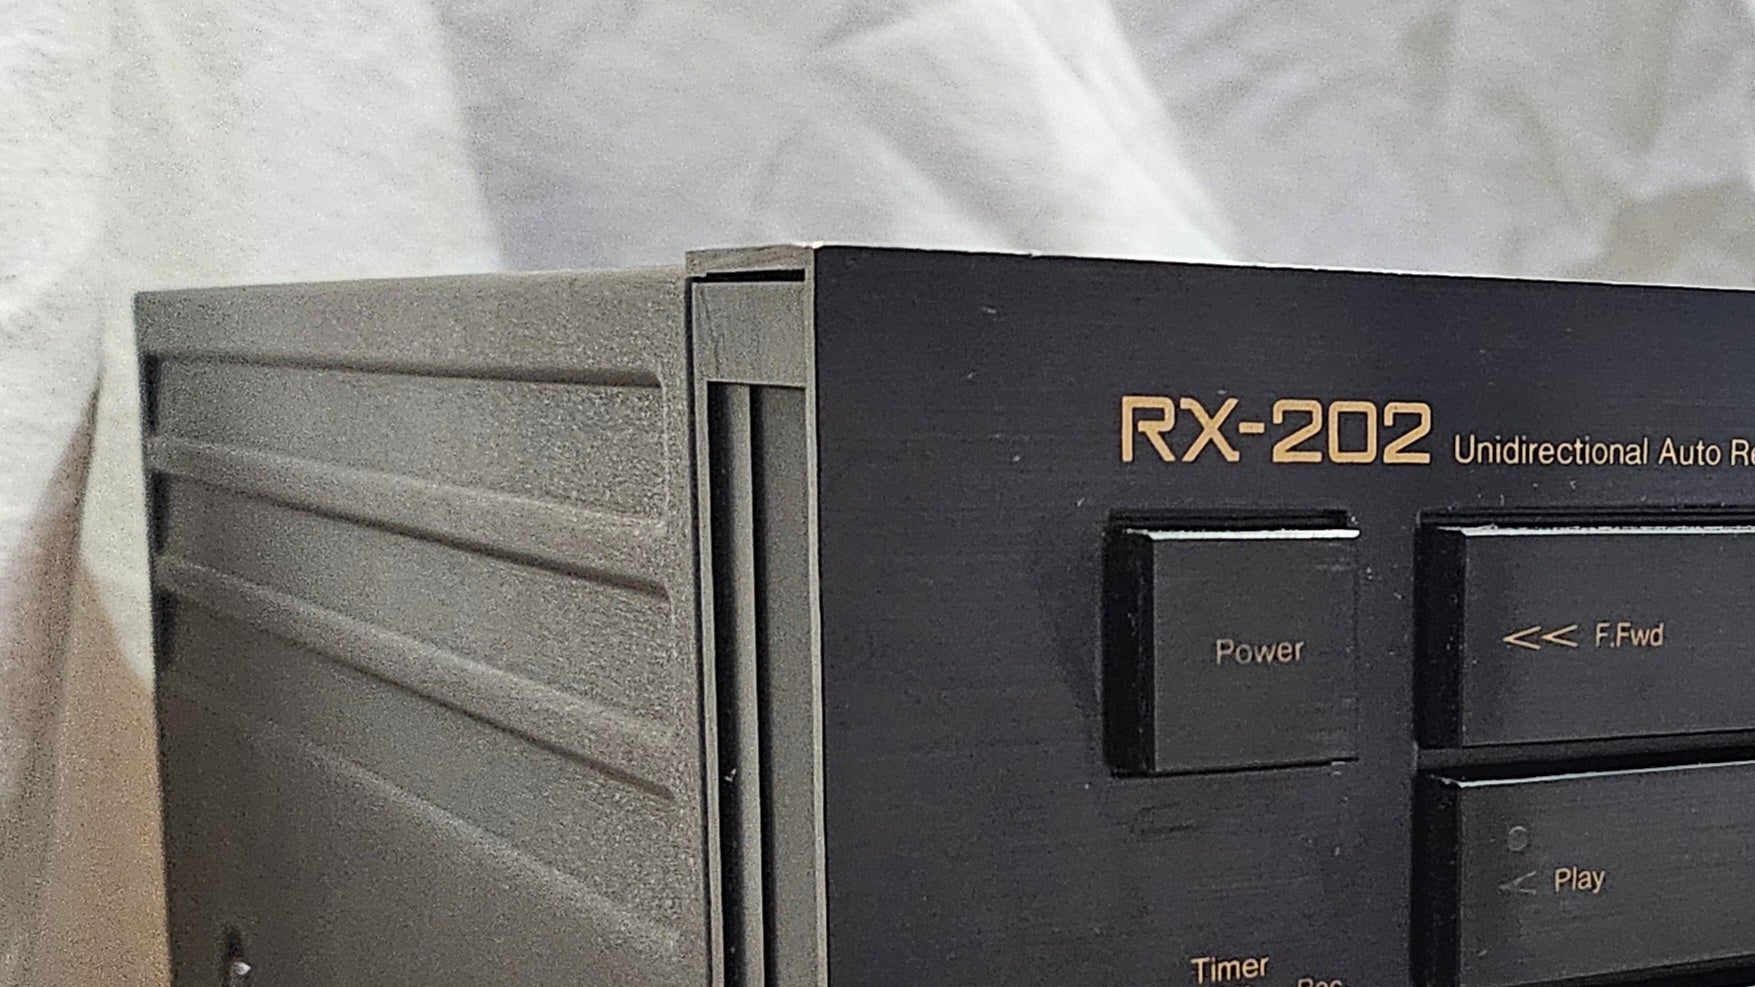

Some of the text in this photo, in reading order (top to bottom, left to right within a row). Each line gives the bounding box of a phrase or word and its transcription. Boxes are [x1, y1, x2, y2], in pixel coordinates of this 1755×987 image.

[1119, 394, 1434, 466] RX-202
[1453, 433, 1650, 466] Unidirectional
[1659, 436, 1722, 468] Auto
[1594, 620, 1666, 649] F.Fwd
[1214, 636, 1305, 665] Power
[1554, 866, 1606, 896] Play
[1190, 954, 1270, 986] Timer
